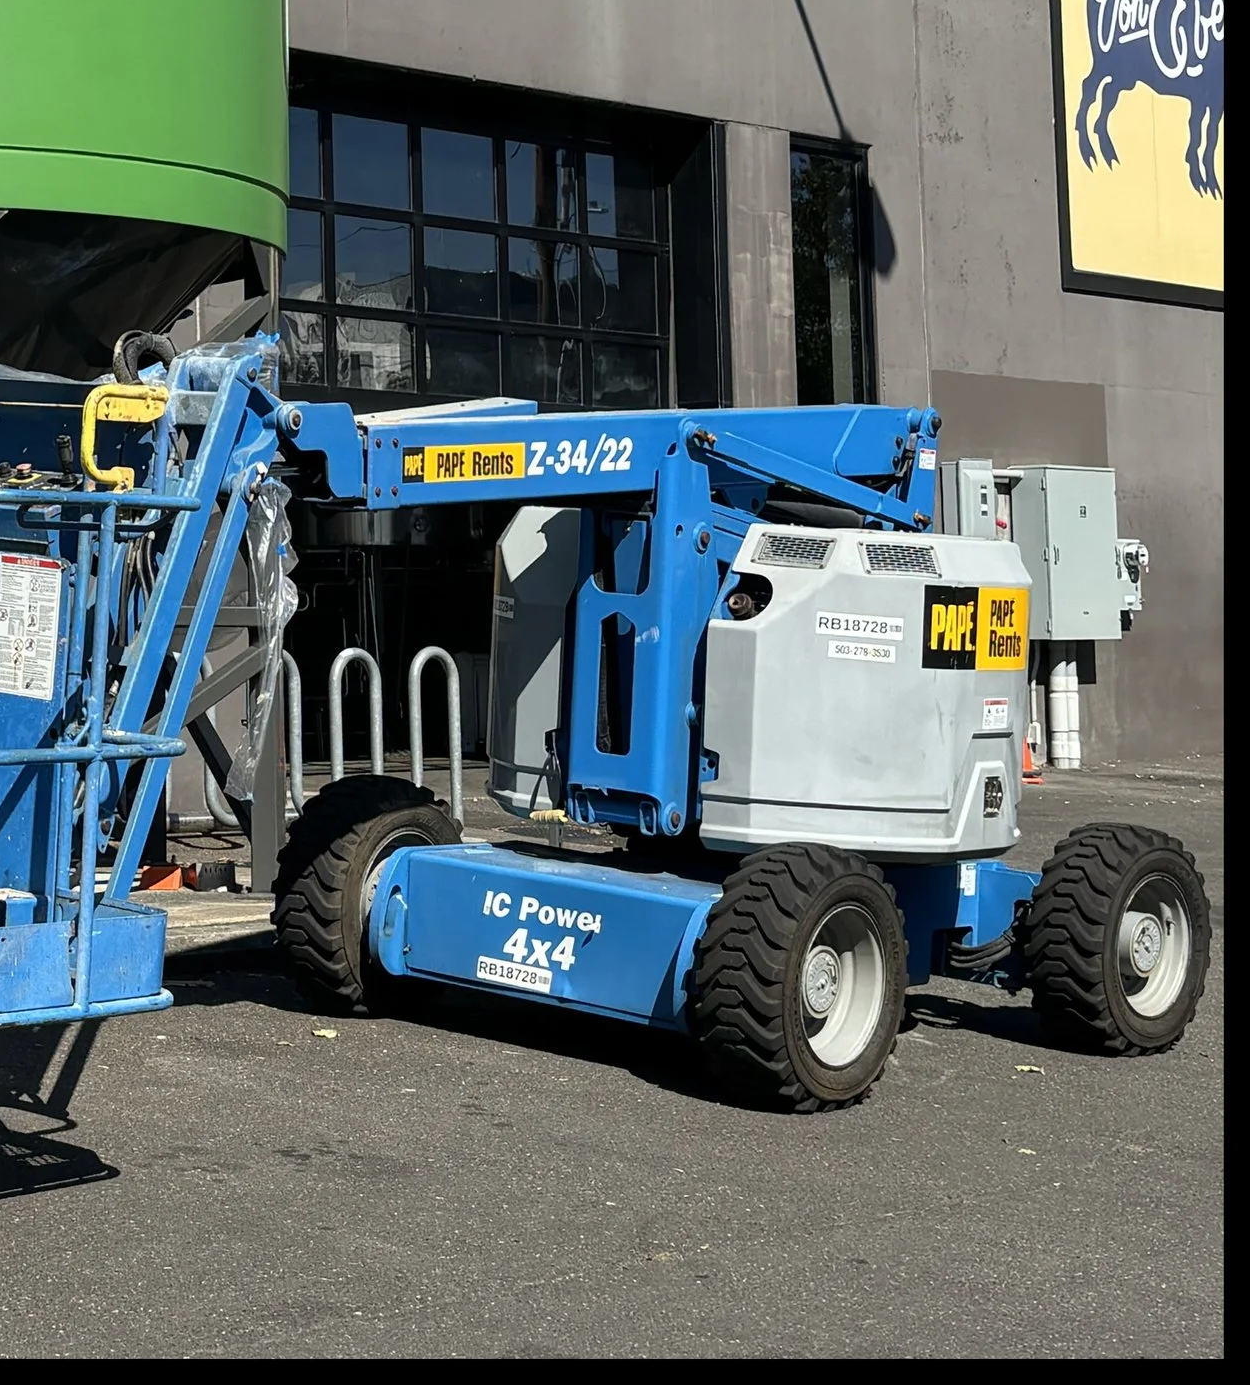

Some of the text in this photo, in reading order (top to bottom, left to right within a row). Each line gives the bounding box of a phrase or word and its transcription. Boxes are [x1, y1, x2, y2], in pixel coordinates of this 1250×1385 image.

[472, 451, 513, 476] Rents
[527, 433, 633, 476] Z-34/22
[819, 616, 888, 634] RB18728
[989, 629, 1021, 658] Rents
[483, 890, 602, 934] IC Power
[503, 928, 576, 971] 4x4
[478, 961, 537, 985] RB18728
